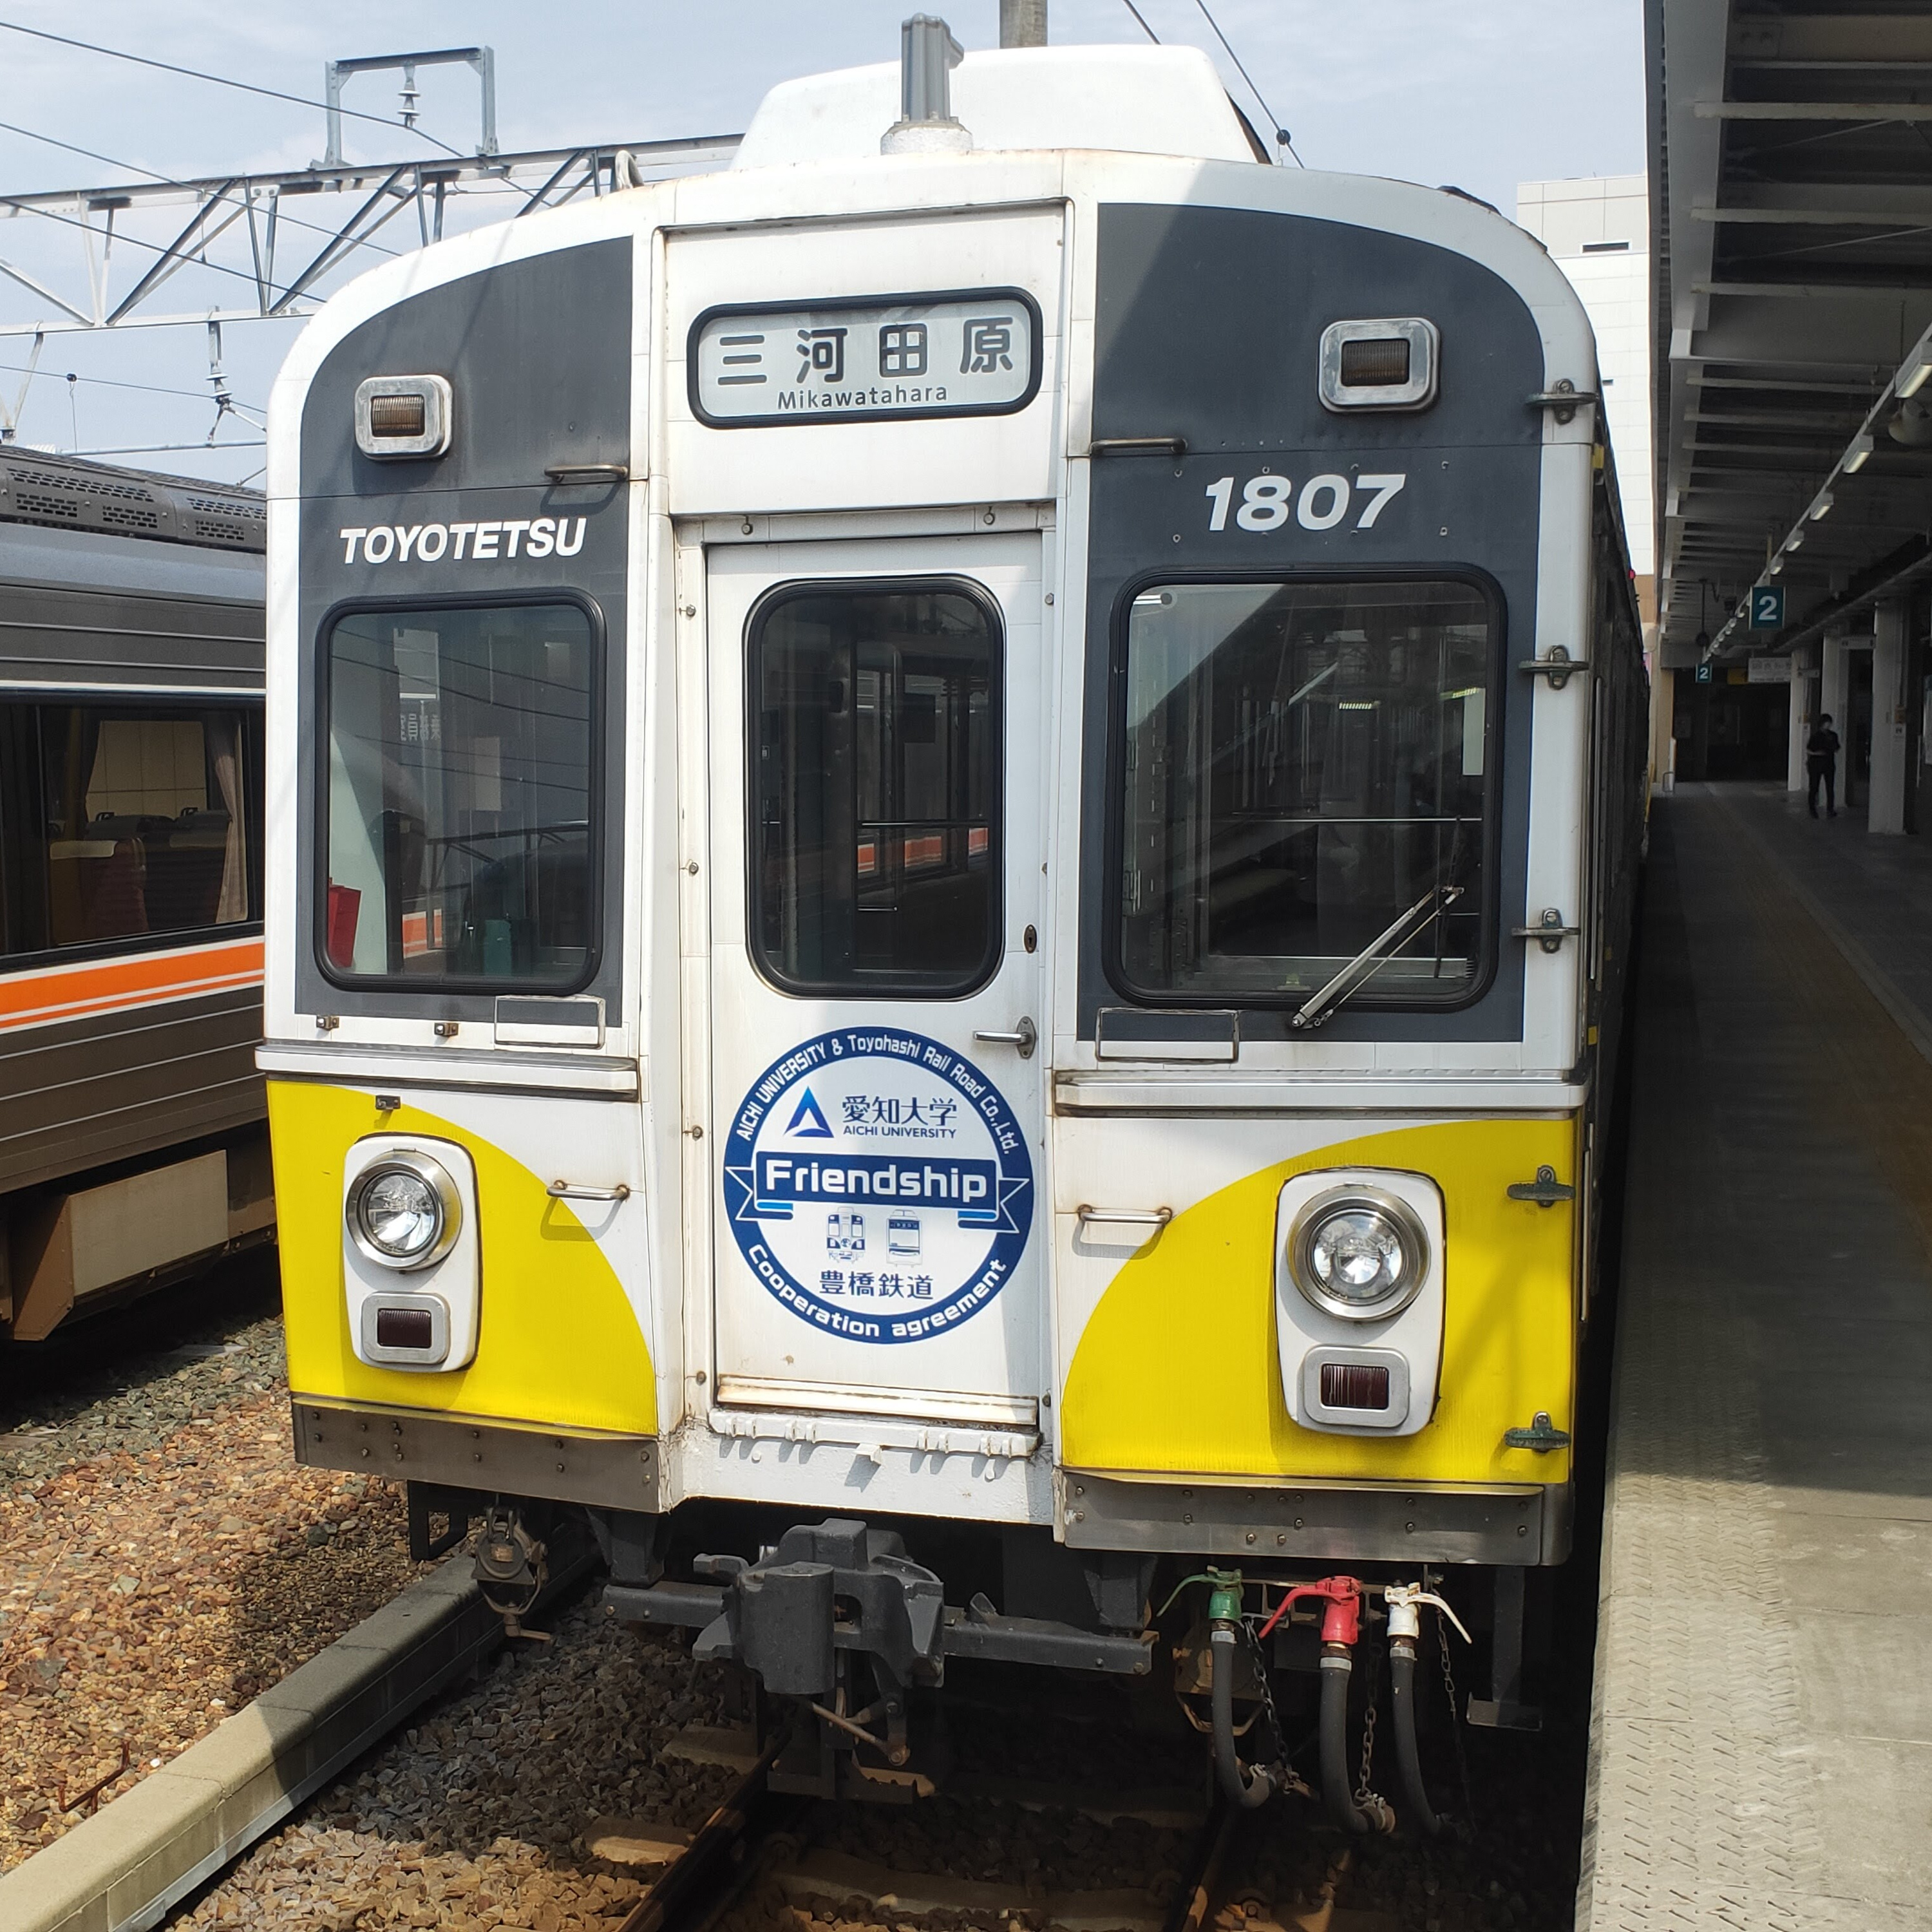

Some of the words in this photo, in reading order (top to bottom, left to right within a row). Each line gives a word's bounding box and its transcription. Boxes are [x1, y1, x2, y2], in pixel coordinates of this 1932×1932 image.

[717, 317, 1014, 386] 三河田原
[777, 385, 948, 411] Mikawatahara
[1205, 474, 1406, 531] 1807
[340, 518, 587, 564] TOYOTETSU
[1758, 596, 1777, 621] 2
[1700, 668, 1708, 679] 2
[736, 1101, 764, 1141] AICHI
[755, 1041, 826, 1104] UNIVERSITY
[831, 1037, 844, 1056] &
[848, 1034, 921, 1059] Toyohashi
[922, 1046, 952, 1072] Rail
[950, 1063, 987, 1099] Road
[842, 1094, 958, 1127] 愛知大学
[842, 1125, 878, 1136] AICHI
[881, 1126, 957, 1139] UNIVERSITY
[766, 1160, 987, 1203] Friendship
[748, 1244, 880, 1337] Cooperation
[891, 1259, 1007, 1337] agreement
[819, 1270, 934, 1300] 豊橋鉄道
